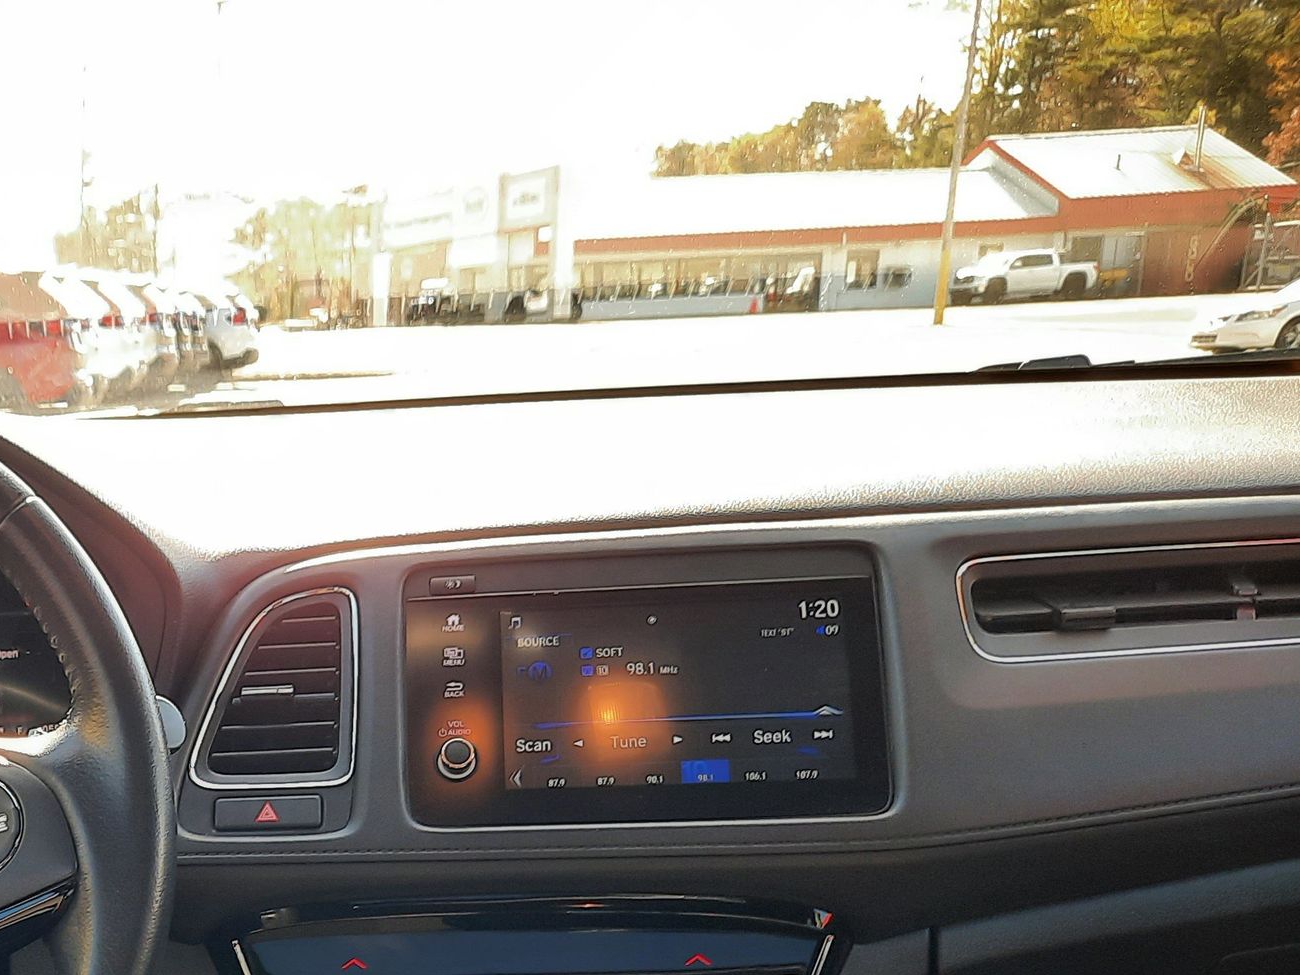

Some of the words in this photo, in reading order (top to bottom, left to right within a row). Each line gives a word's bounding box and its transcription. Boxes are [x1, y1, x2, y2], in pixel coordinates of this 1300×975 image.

[798, 600, 840, 619] 1:20
[517, 636, 560, 647] SOURCE
[596, 647, 623, 657] SOFT
[626, 663, 655, 675] 98.1
[444, 690, 465, 698] BACK
[611, 736, 647, 749] Tune
[753, 729, 792, 744] Seek
[516, 738, 551, 753] Scan
